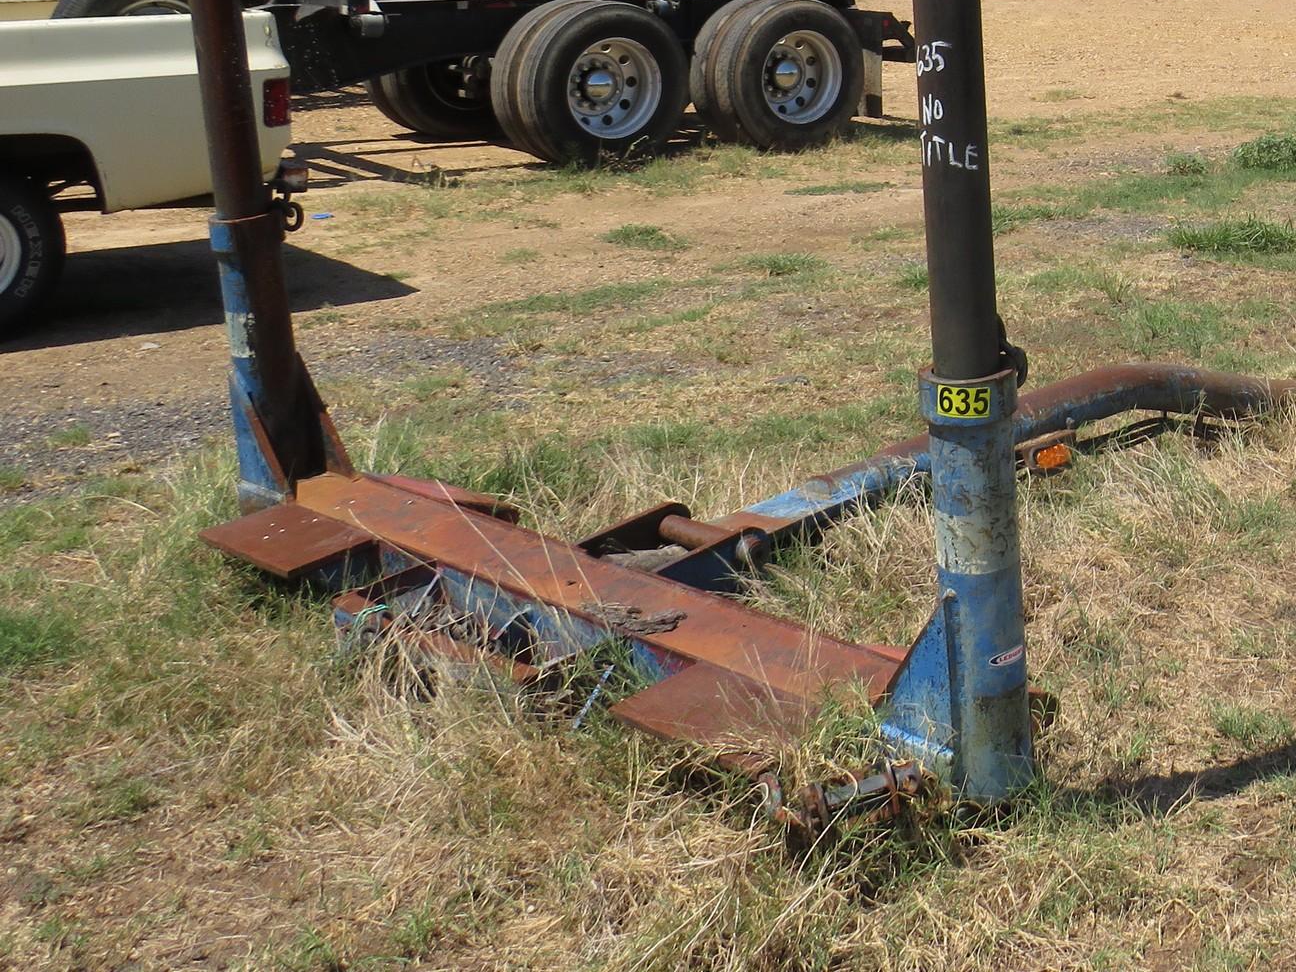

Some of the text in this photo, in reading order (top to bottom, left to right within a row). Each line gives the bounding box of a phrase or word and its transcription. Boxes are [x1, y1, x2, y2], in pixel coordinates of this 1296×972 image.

[916, 40, 952, 77] 635
[922, 93, 945, 126] NO
[920, 130, 979, 170] TITLE
[939, 387, 989, 415] 635
